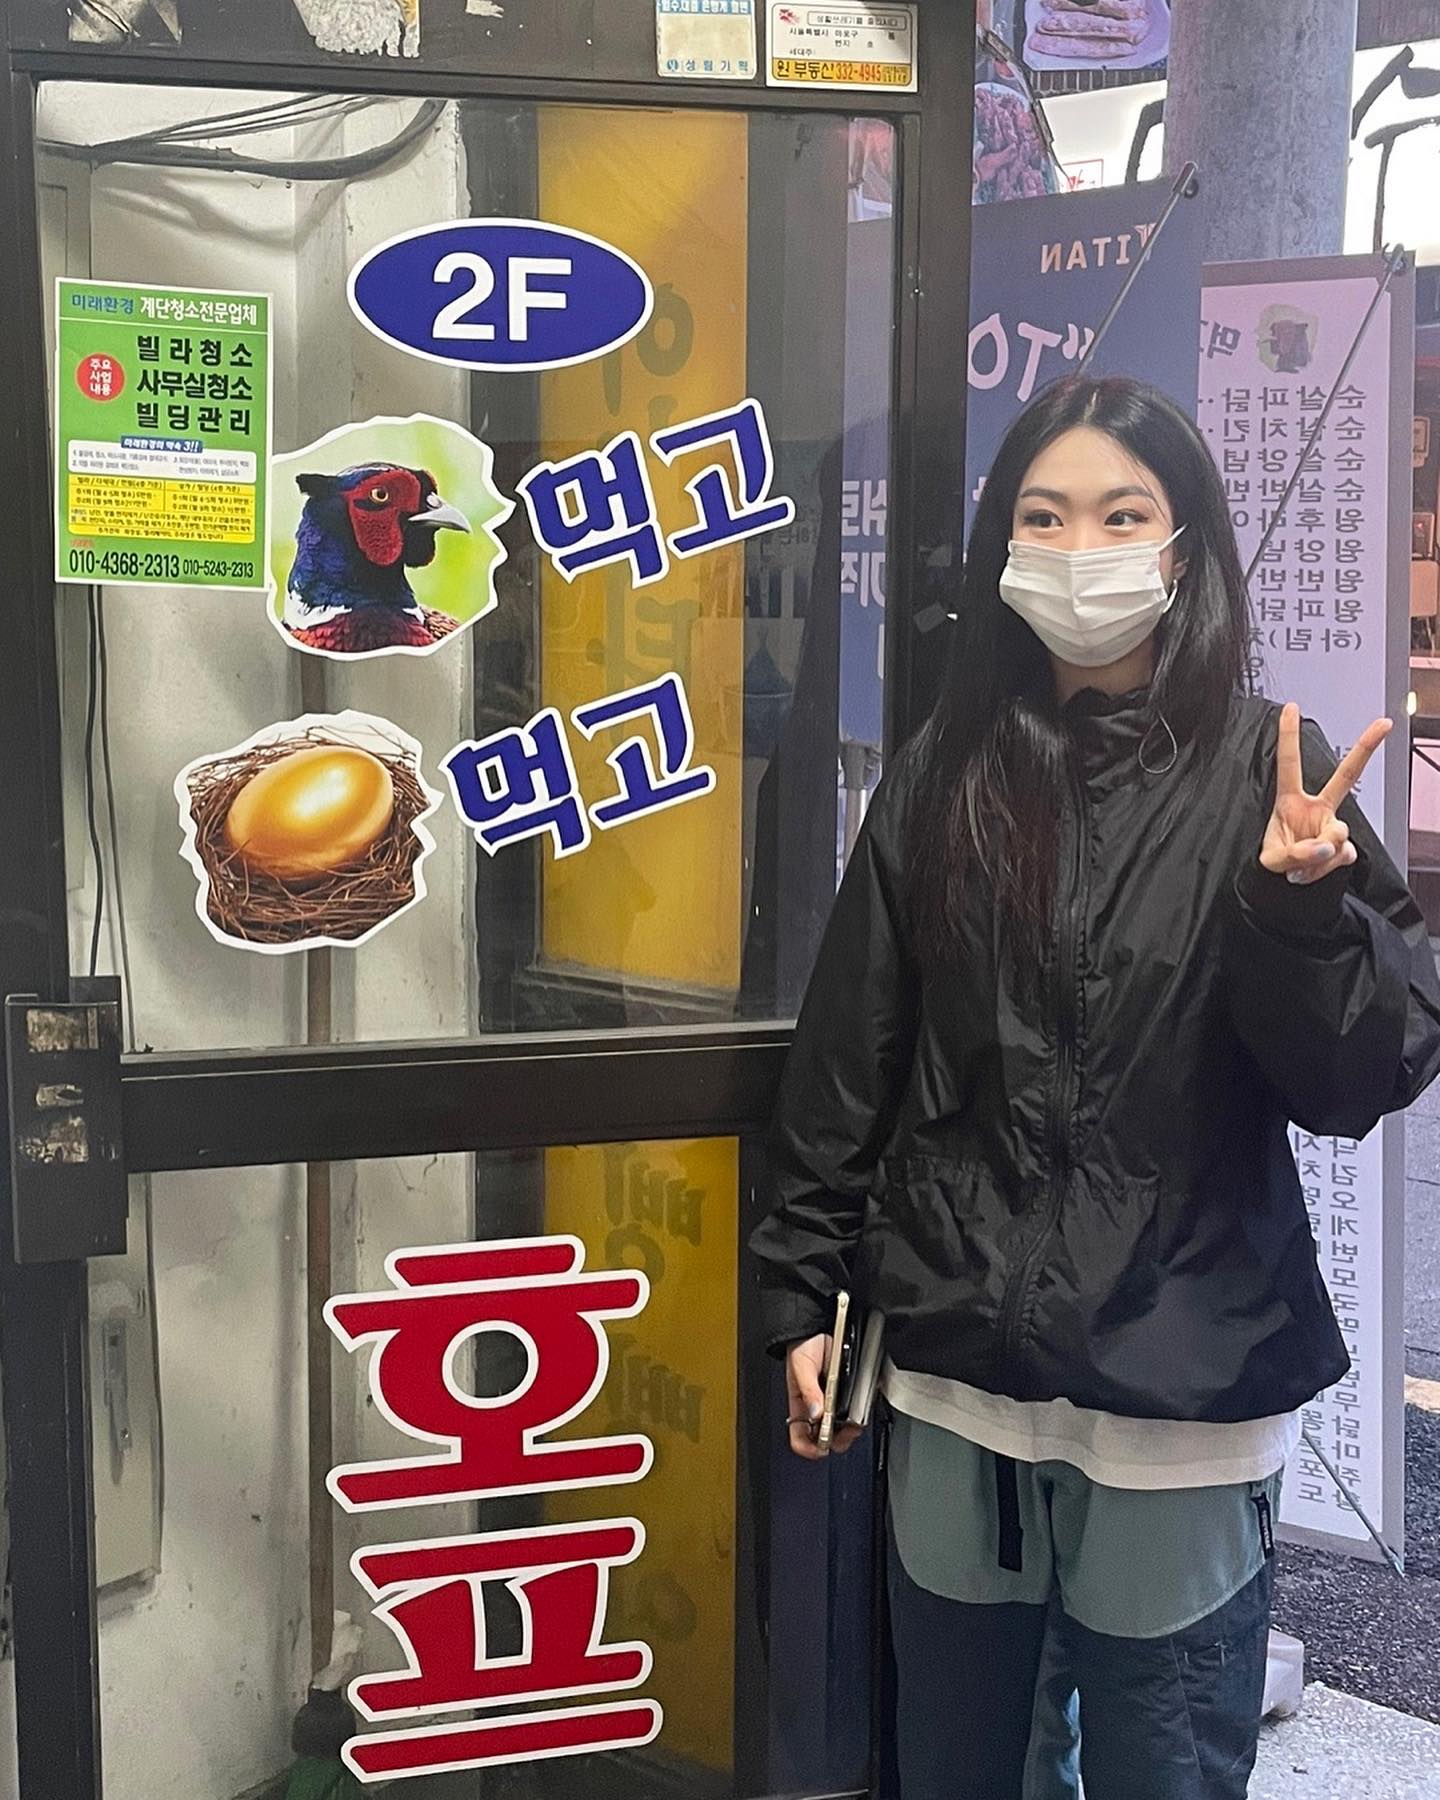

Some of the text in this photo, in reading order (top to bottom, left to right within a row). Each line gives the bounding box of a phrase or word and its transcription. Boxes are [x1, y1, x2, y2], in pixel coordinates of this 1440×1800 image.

[777, 60, 790, 78] 원
[794, 61, 835, 80] 부동산
[835, 62, 881, 82] 332-4945
[71, 293, 257, 326] 미래환경 계단청소전문업체
[432, 252, 572, 342] 2F
[89, 357, 113, 371] 주요
[89, 370, 113, 383] 사업
[89, 381, 113, 396] 내용
[136, 369, 253, 401] 사무실청소
[521, 402, 792, 584] 먹고
[69, 549, 254, 578] 010-4368-2313 010-5243-2313
[442, 674, 714, 857] 먹고
[328, 1240, 660, 1779] 호프
